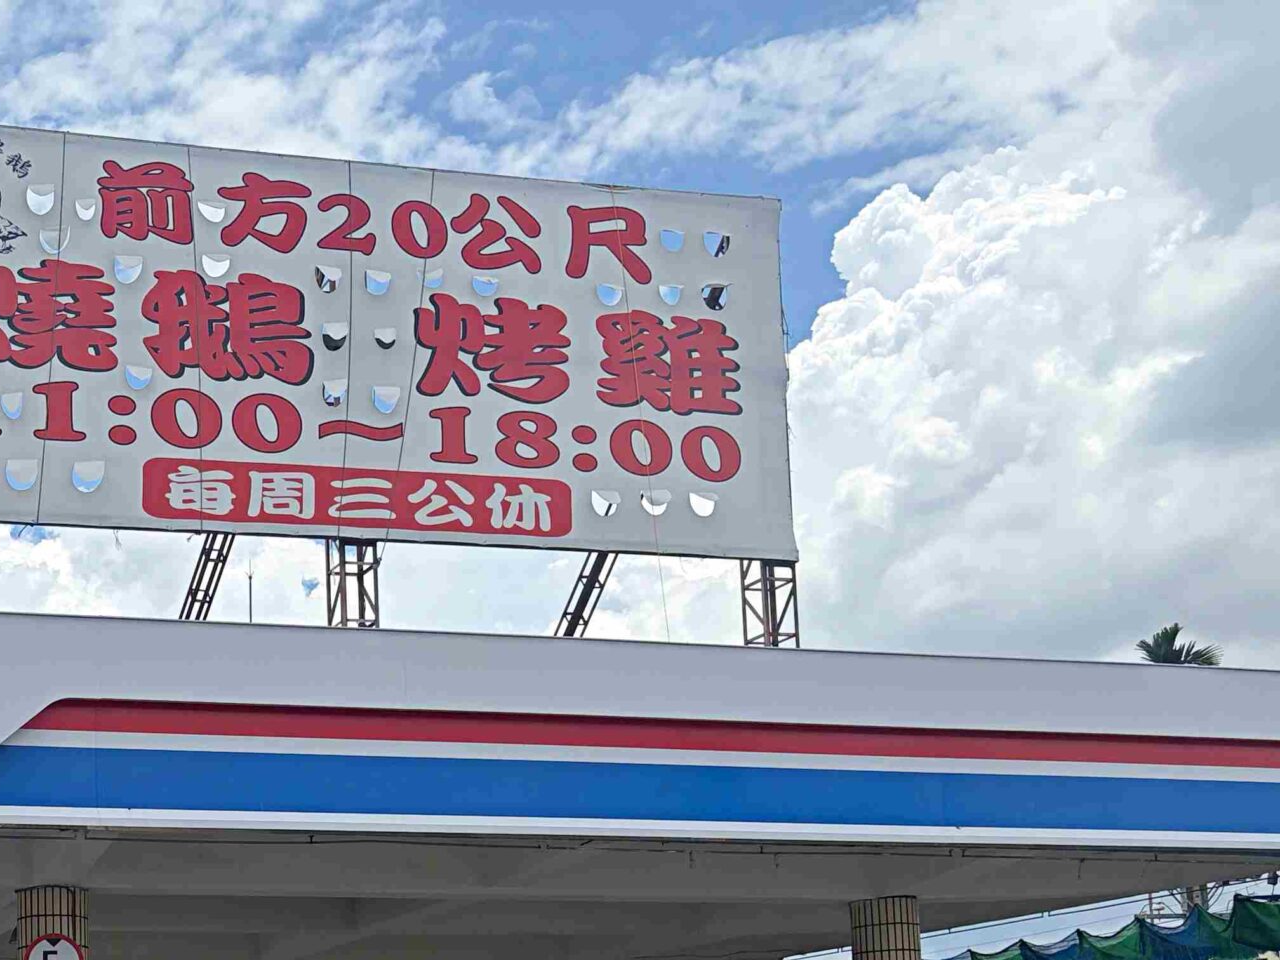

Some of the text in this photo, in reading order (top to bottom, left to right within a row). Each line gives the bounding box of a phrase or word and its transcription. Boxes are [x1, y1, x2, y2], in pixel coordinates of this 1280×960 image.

[97, 160, 648, 285] 前方20公尺
[416, 292, 742, 416] 烤雞
[167, 464, 551, 538] 每周三公休
